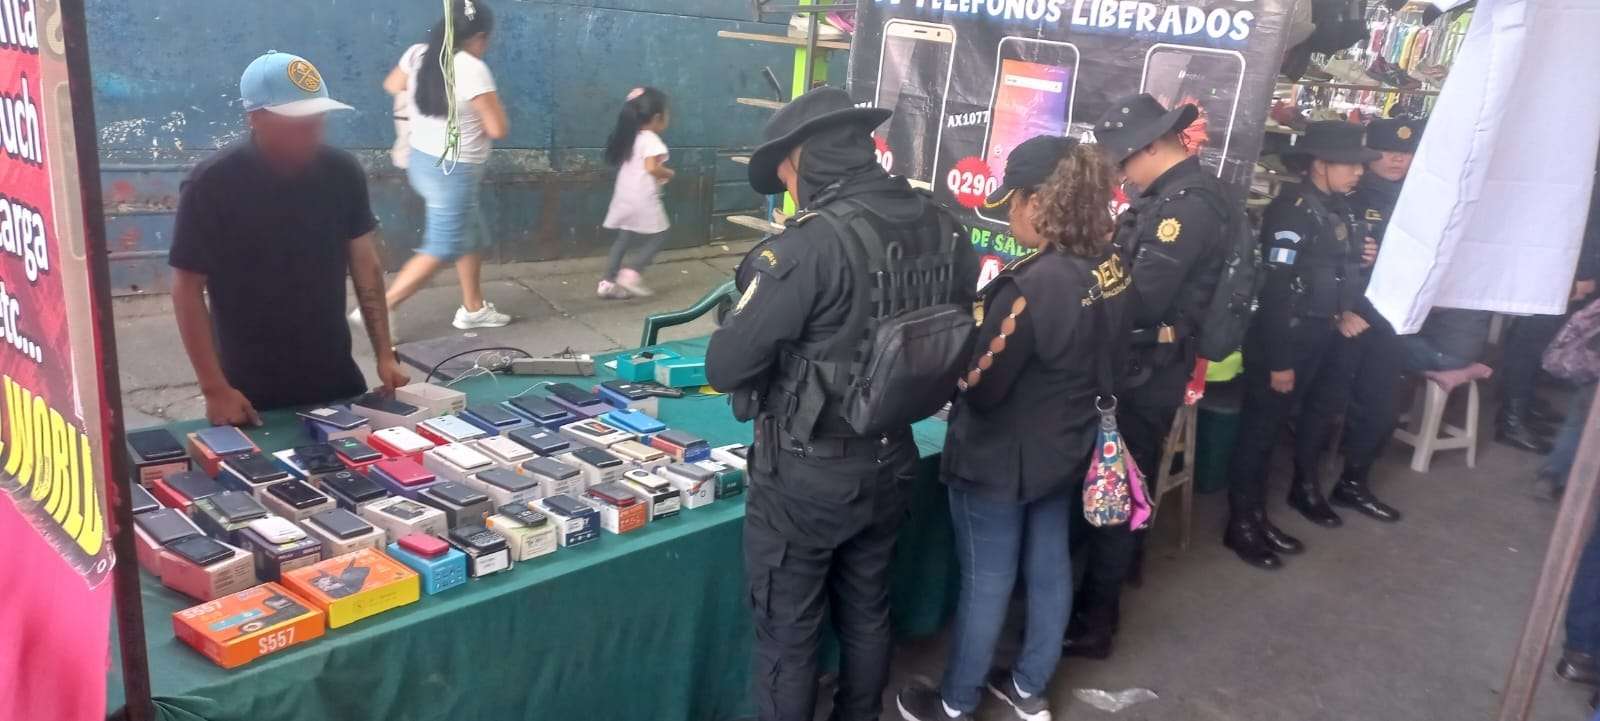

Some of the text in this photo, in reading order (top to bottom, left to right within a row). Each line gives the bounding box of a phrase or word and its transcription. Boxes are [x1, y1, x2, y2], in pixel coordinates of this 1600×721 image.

[914, 0, 1255, 41] LEFONOS LIBERADOS
[947, 110, 989, 128] AX1077
[947, 168, 998, 197] Q290
[0, 198, 49, 282] arga
[971, 227, 992, 248] DE
[258, 627, 296, 655] S557
